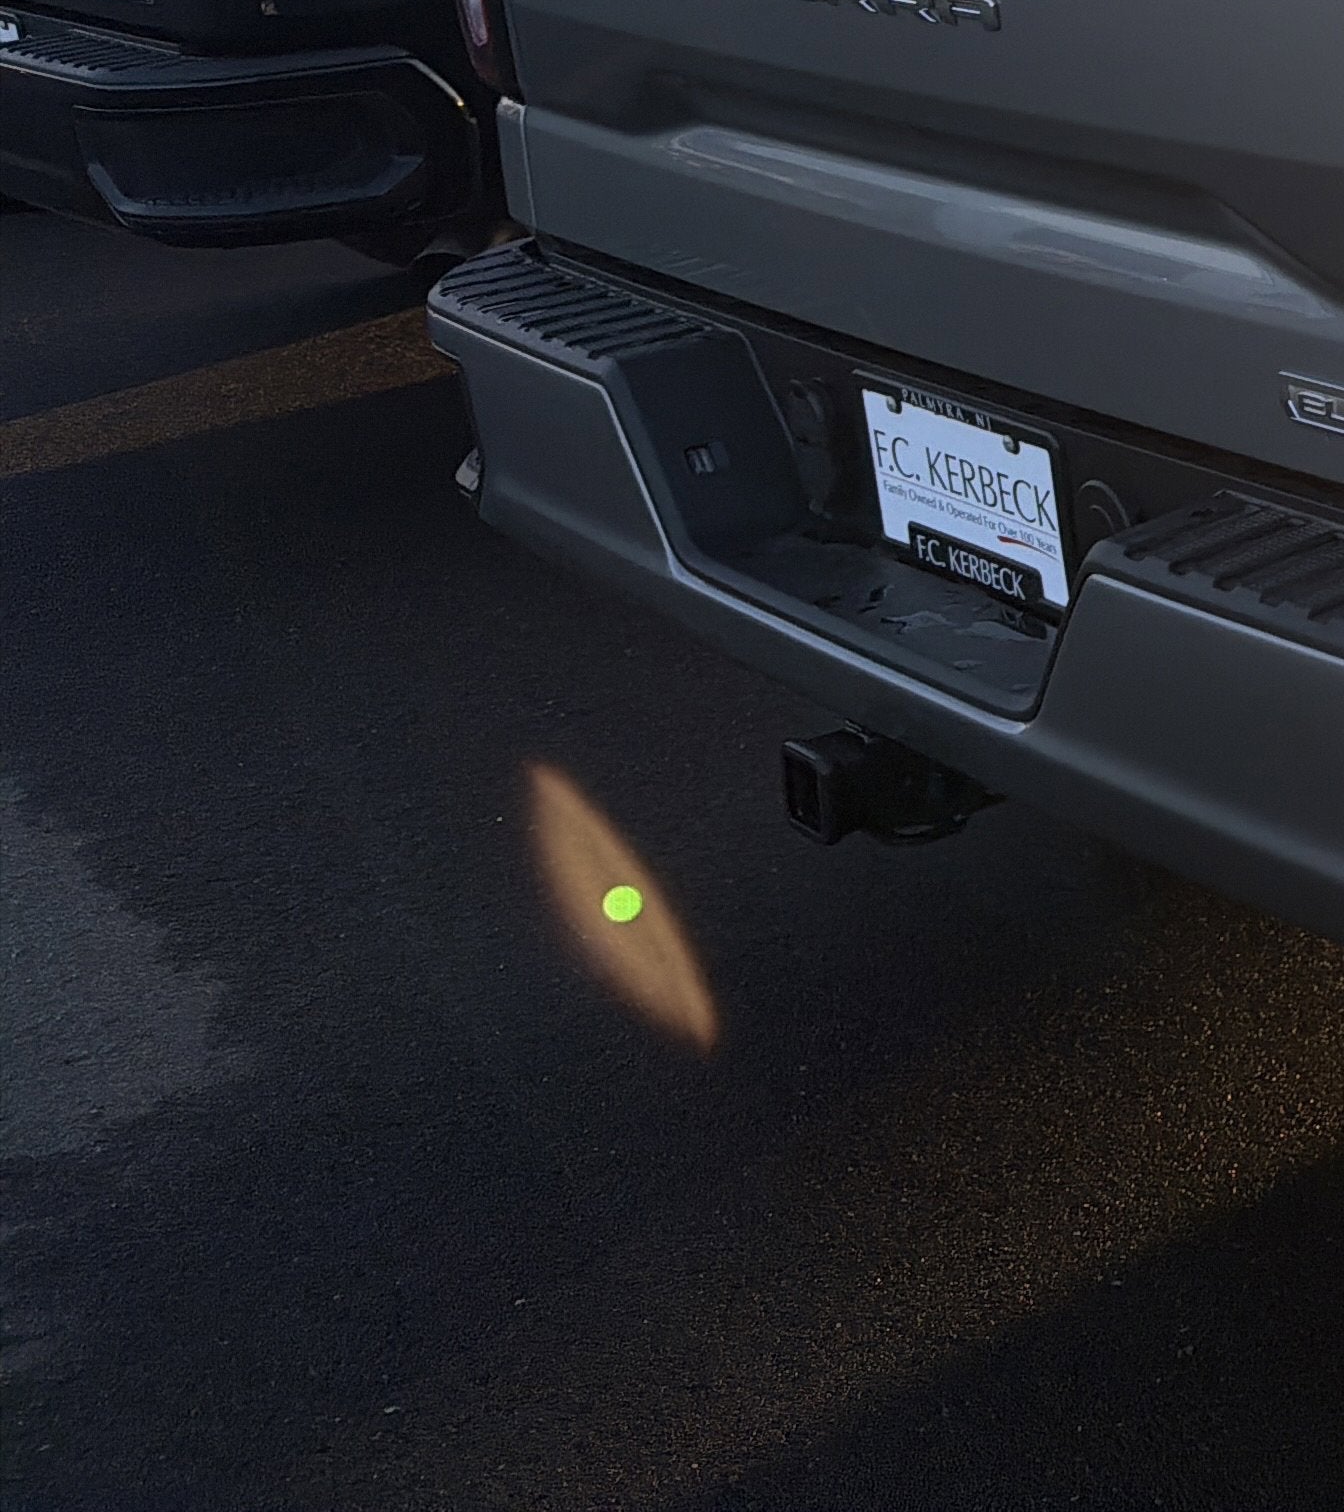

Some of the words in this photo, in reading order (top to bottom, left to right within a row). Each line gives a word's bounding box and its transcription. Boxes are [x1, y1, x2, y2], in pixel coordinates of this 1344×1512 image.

[902, 388, 970, 424] PALMYRA,
[975, 413, 992, 431] NJ
[874, 429, 920, 481] F.C.
[926, 446, 1056, 531] KERBECK
[883, 480, 907, 500] Family
[908, 489, 937, 509] Owned
[946, 502, 982, 525] Operated
[983, 516, 997, 530] For
[998, 521, 1017, 537] Over
[1020, 530, 1034, 545] 100
[1036, 536, 1057, 554] Years
[916, 535, 945, 568] F.C.
[948, 546, 1026, 600] KERBECK
